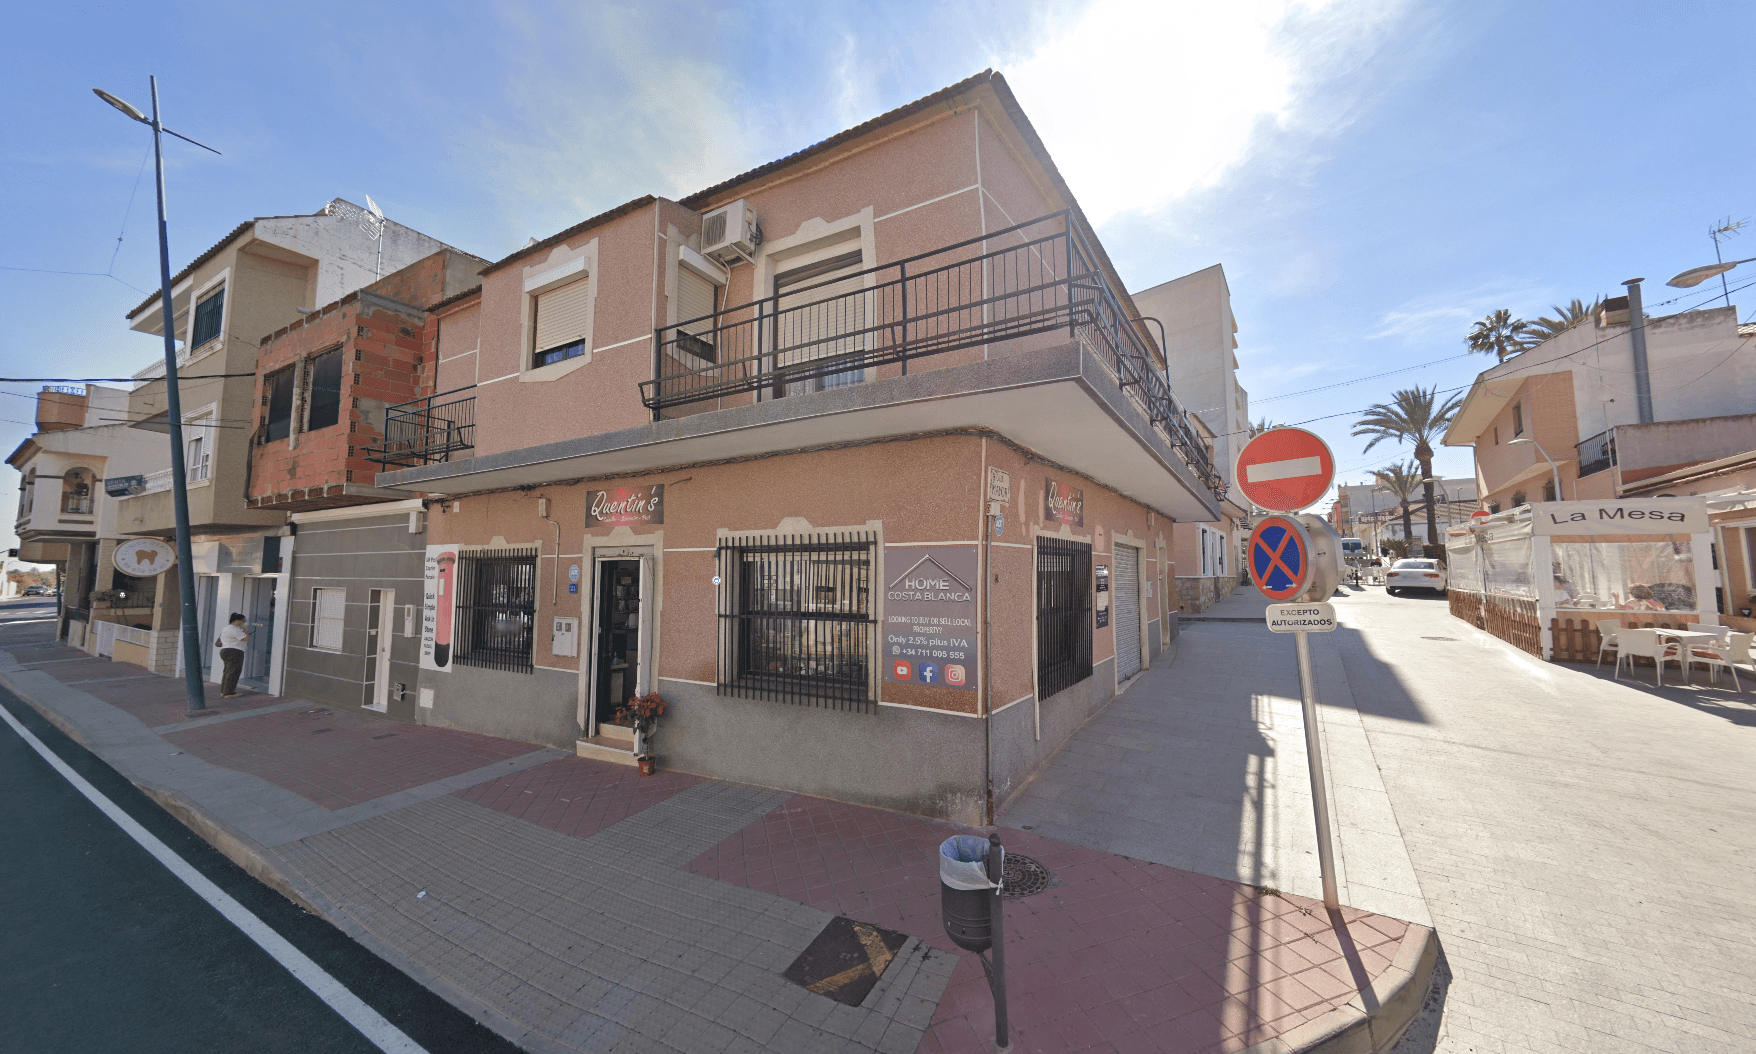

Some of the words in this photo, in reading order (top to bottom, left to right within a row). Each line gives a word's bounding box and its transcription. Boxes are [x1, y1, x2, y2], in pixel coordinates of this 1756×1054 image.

[591, 486, 659, 521] Quentin's
[1550, 511, 1586, 525] La
[1600, 507, 1686, 523] Mesa
[905, 578, 949, 590] HOME
[888, 591, 922, 601] COSTA
[924, 592, 971, 602] BLANCA
[940, 617, 952, 625] SELL
[953, 618, 971, 626] LOCAL
[913, 626, 942, 634] PROPERTY?
[888, 635, 907, 644] Only
[929, 638, 948, 646] plus
[950, 638, 968, 647] IVA
